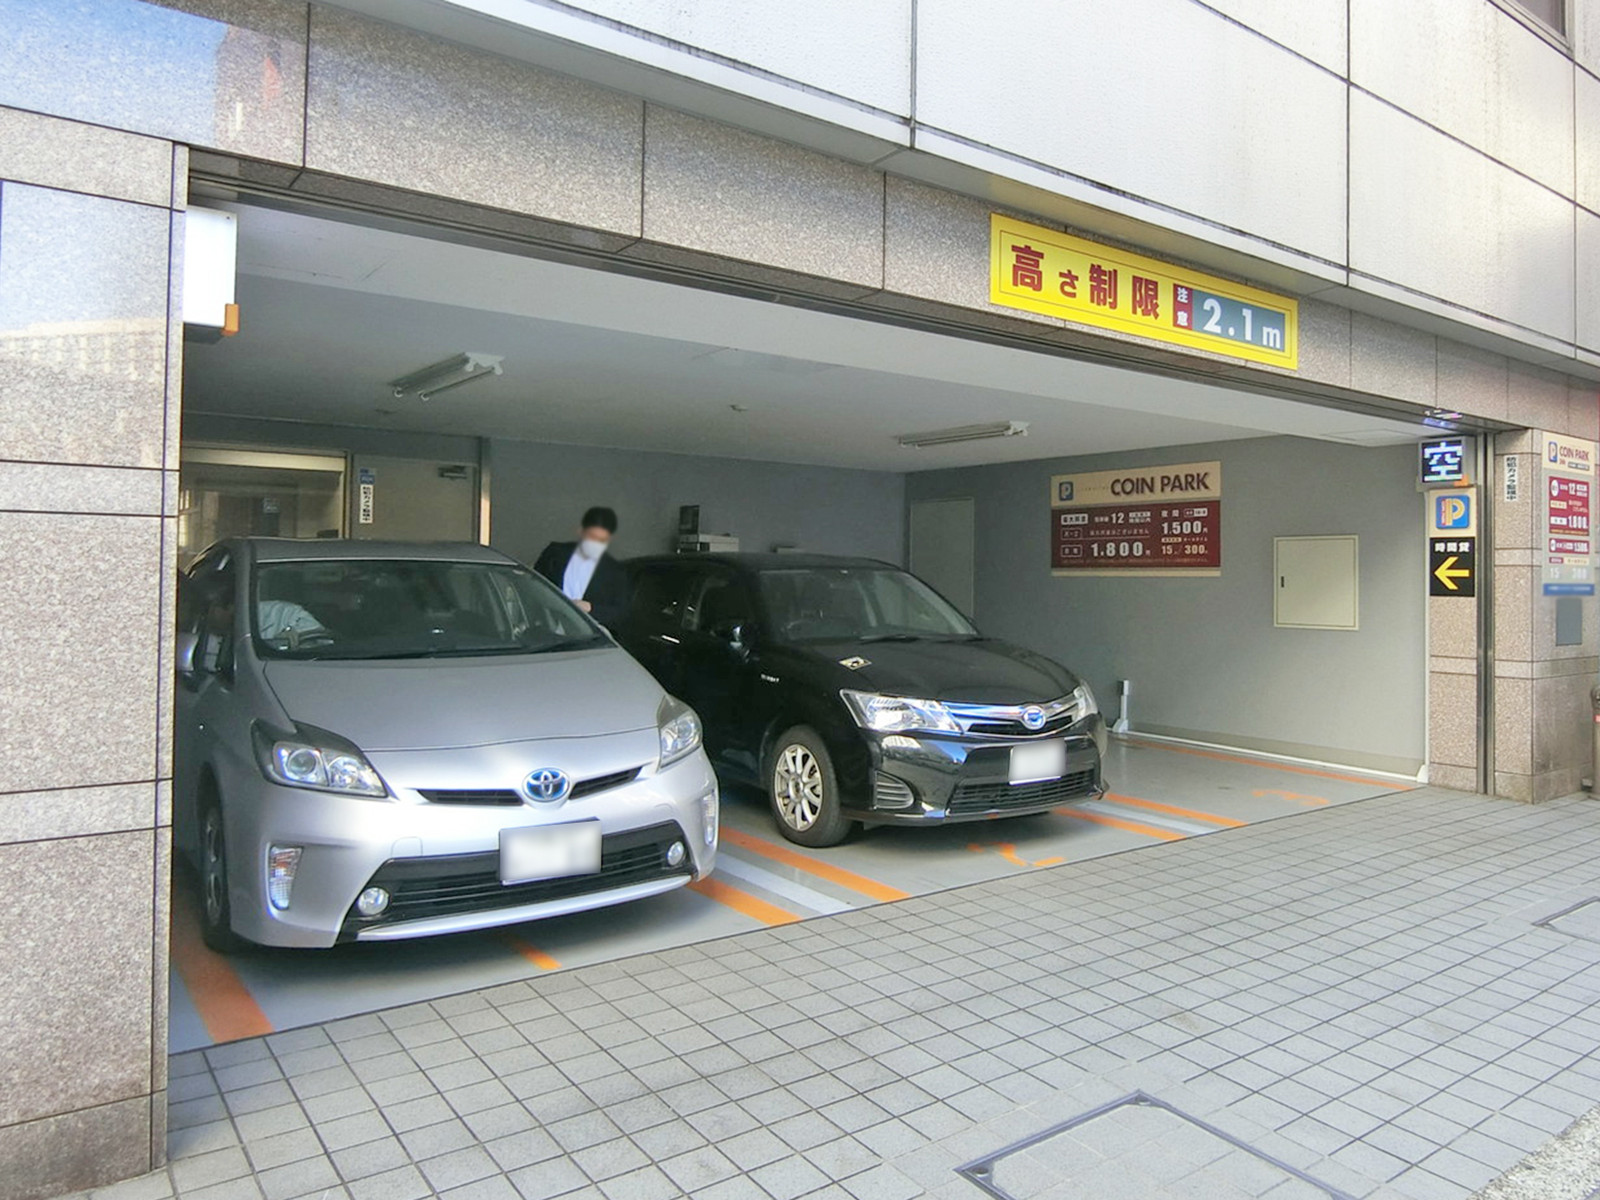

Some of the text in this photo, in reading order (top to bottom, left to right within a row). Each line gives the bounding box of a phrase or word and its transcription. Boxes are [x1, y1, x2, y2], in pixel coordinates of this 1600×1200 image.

[1011, 245, 1159, 320] 高さ制限
[1424, 441, 1463, 482] 空
[1559, 446, 1589, 462] COIN PARK
[1110, 472, 1210, 496] COIN PARK
[1111, 512, 1124, 524] 12
